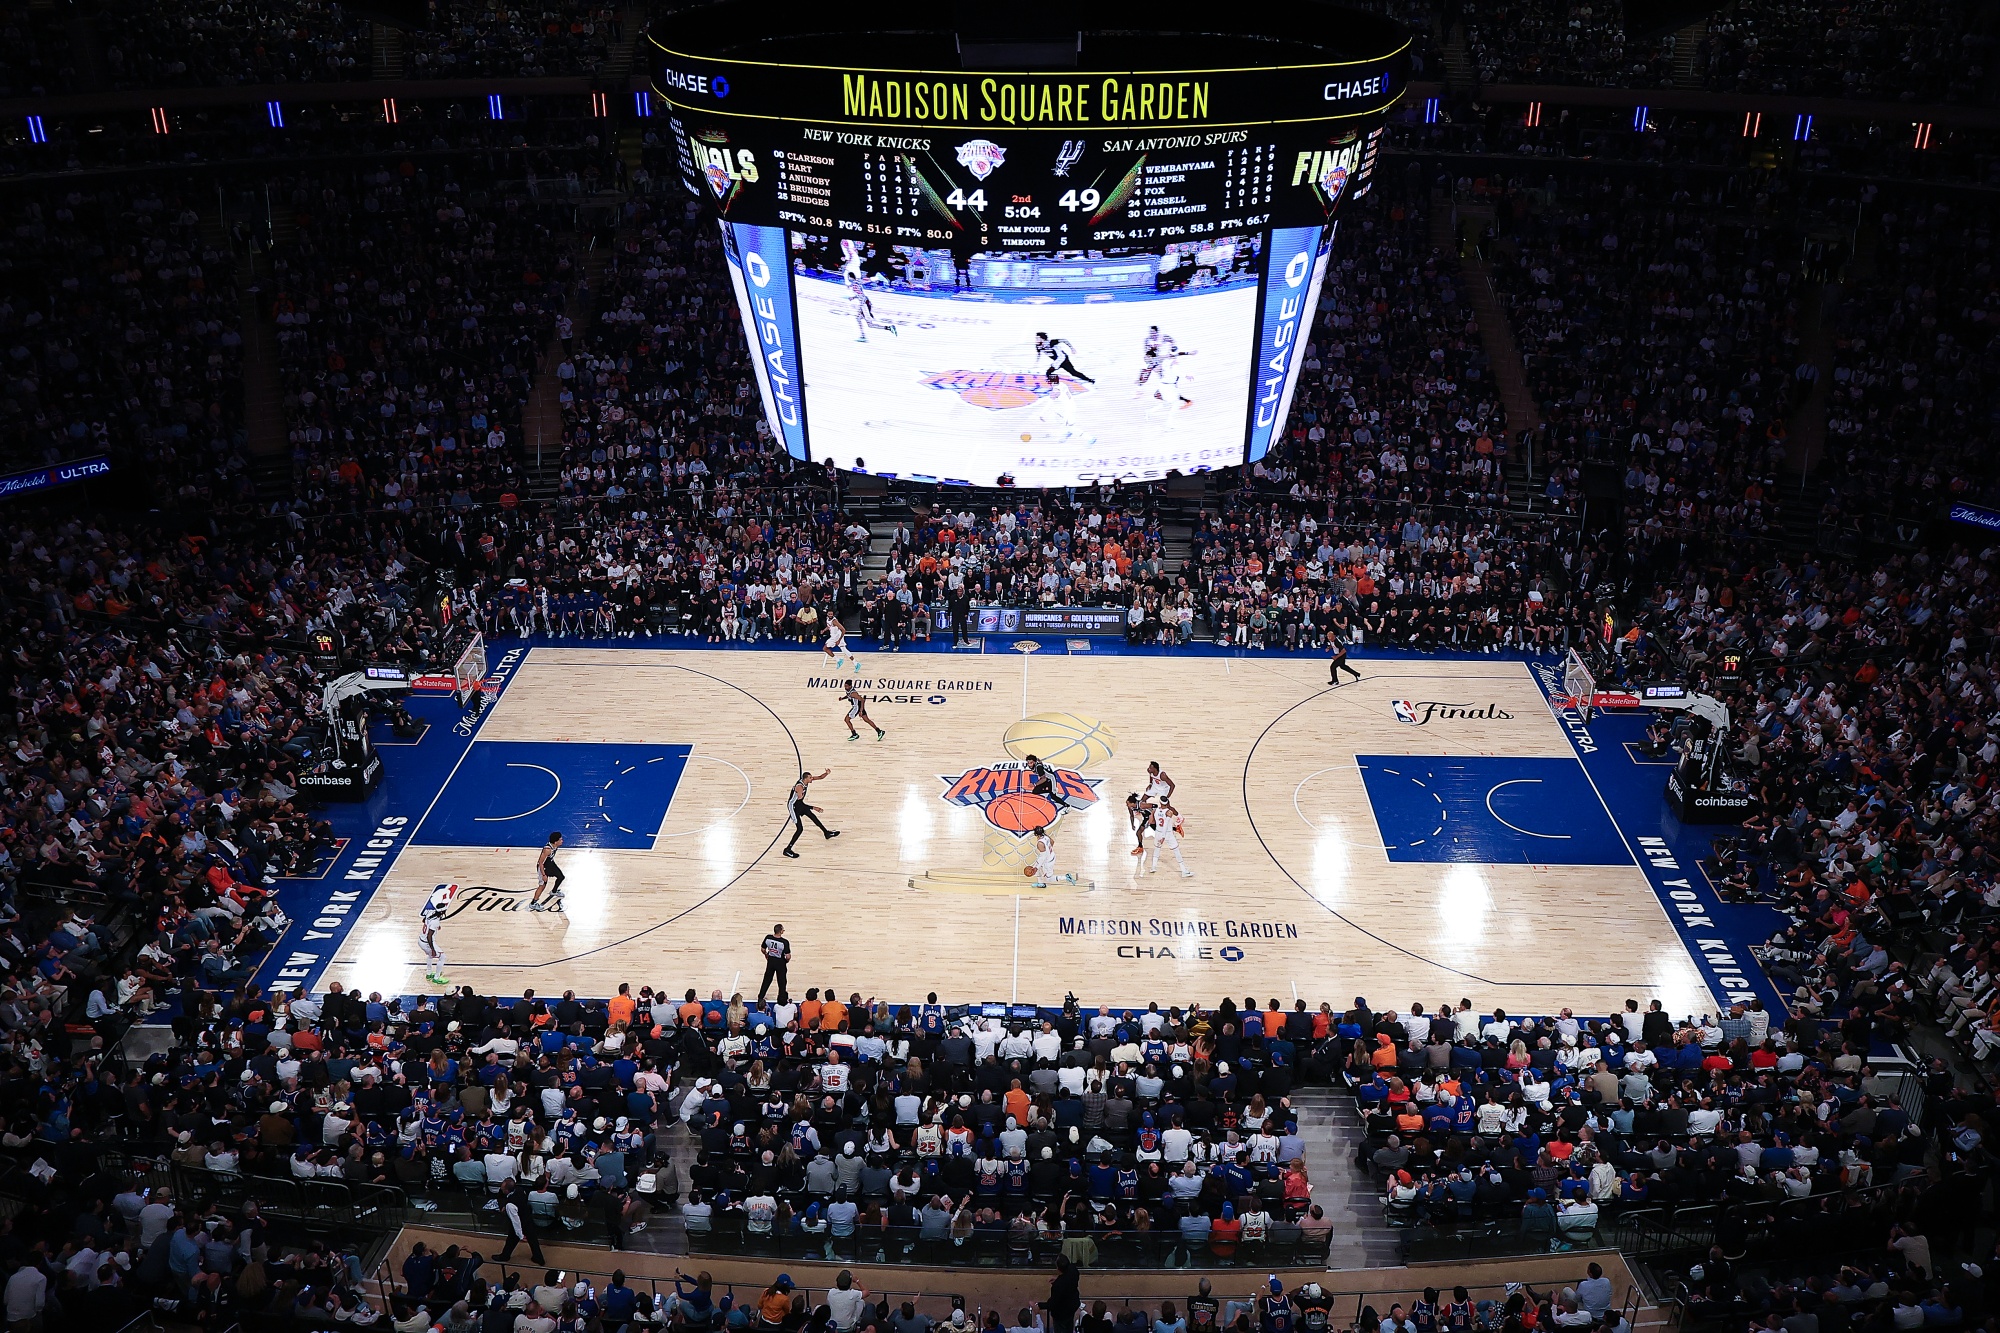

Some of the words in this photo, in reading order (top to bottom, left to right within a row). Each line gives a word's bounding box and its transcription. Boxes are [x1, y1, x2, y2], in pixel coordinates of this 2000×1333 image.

[666, 68, 708, 94] CHASE
[1324, 76, 1380, 101] CHASE
[844, 74, 968, 120] MADISON
[980, 78, 1090, 125] SQUARE
[1102, 78, 1209, 122] GARDEN
[803, 128, 833, 142] NEW
[836, 132, 873, 146] YORK
[876, 136, 931, 150] KNICKS
[1102, 140, 1134, 152] SAN
[1135, 135, 1201, 151] ANTONIO
[1204, 130, 1248, 146] SPURS
[774, 150, 784, 158] 00
[787, 152, 834, 166] CLARKSON
[788, 163, 812, 173] HART
[1145, 161, 1215, 174] WEMBANYAMA
[788, 174, 830, 186] ANUNOBY
[1145, 175, 1185, 185] HARPER
[778, 182, 787, 190] 11
[790, 184, 831, 196] BRUNSON
[1145, 187, 1165, 196] FOX
[778, 192, 788, 200] 25
[790, 194, 830, 207] BRIDGES
[946, 188, 988, 212] 44
[1012, 195, 1032, 203] 2nd
[1058, 188, 1100, 212] 49
[1128, 199, 1141, 207] 24
[1144, 196, 1186, 206] VASSELL
[1004, 206, 1041, 218] 5:04
[1144, 204, 1207, 217] CHAMPAGNIE
[779, 211, 806, 223] 3PT%
[809, 216, 833, 228] 30.8
[838, 220, 863, 232] FG%
[867, 224, 892, 235] 51.6
[897, 226, 922, 238] FT%
[926, 230, 953, 239] 80.0
[981, 223, 988, 232] 3
[1060, 224, 1068, 232] 4
[1093, 228, 1125, 240] 3PT%
[1129, 228, 1155, 238] 41.7
[1160, 226, 1185, 236] FG%
[1190, 223, 1214, 233] 58.8
[1220, 218, 1242, 229] FT%
[1246, 214, 1270, 225] 66.7
[981, 237, 988, 245] 5
[1060, 237, 1068, 245] 5
[755, 294, 797, 426] CHASE
[1258, 293, 1300, 428] CHASE
[0, 475, 46, 494] Michelob
[60, 462, 110, 479] ULTRA
[320, 643, 332, 651] 17
[487, 648, 524, 684] ULTRA
[1725, 663, 1737, 671] 17
[807, 678, 872, 688] MADION
[877, 678, 932, 690] SQUARE
[937, 679, 992, 691] GARDEN
[862, 695, 923, 703] HASE
[1410, 702, 1514, 726] Finals
[1562, 712, 1598, 753] ULTRA
[300, 775, 352, 785] coinbase
[945, 768, 1100, 801] KNICS
[1695, 796, 1748, 806] coinbase
[1158, 818, 1164, 827] 3
[268, 952, 320, 992] NEW
[302, 890, 361, 941] YORK
[344, 816, 408, 880] KNICKS
[1637, 836, 1680, 870] NEW
[1662, 878, 1714, 928] YORK
[1696, 938, 1757, 1004] KNICK
[1060, 917, 1141, 935] MADISON
[1150, 919, 1218, 937] SQUARE
[1226, 920, 1298, 938] GARDEN
[928, 1016, 936, 1028] 5
[827, 1076, 841, 1086] 15
[1223, 1118, 1237, 1128] 32
[1458, 1111, 1472, 1123] 17
[509, 1134, 523, 1145] 32
[920, 1142, 936, 1152] 25
[981, 1173, 996, 1185] 25
[1012, 1176, 1022, 1186] 11
